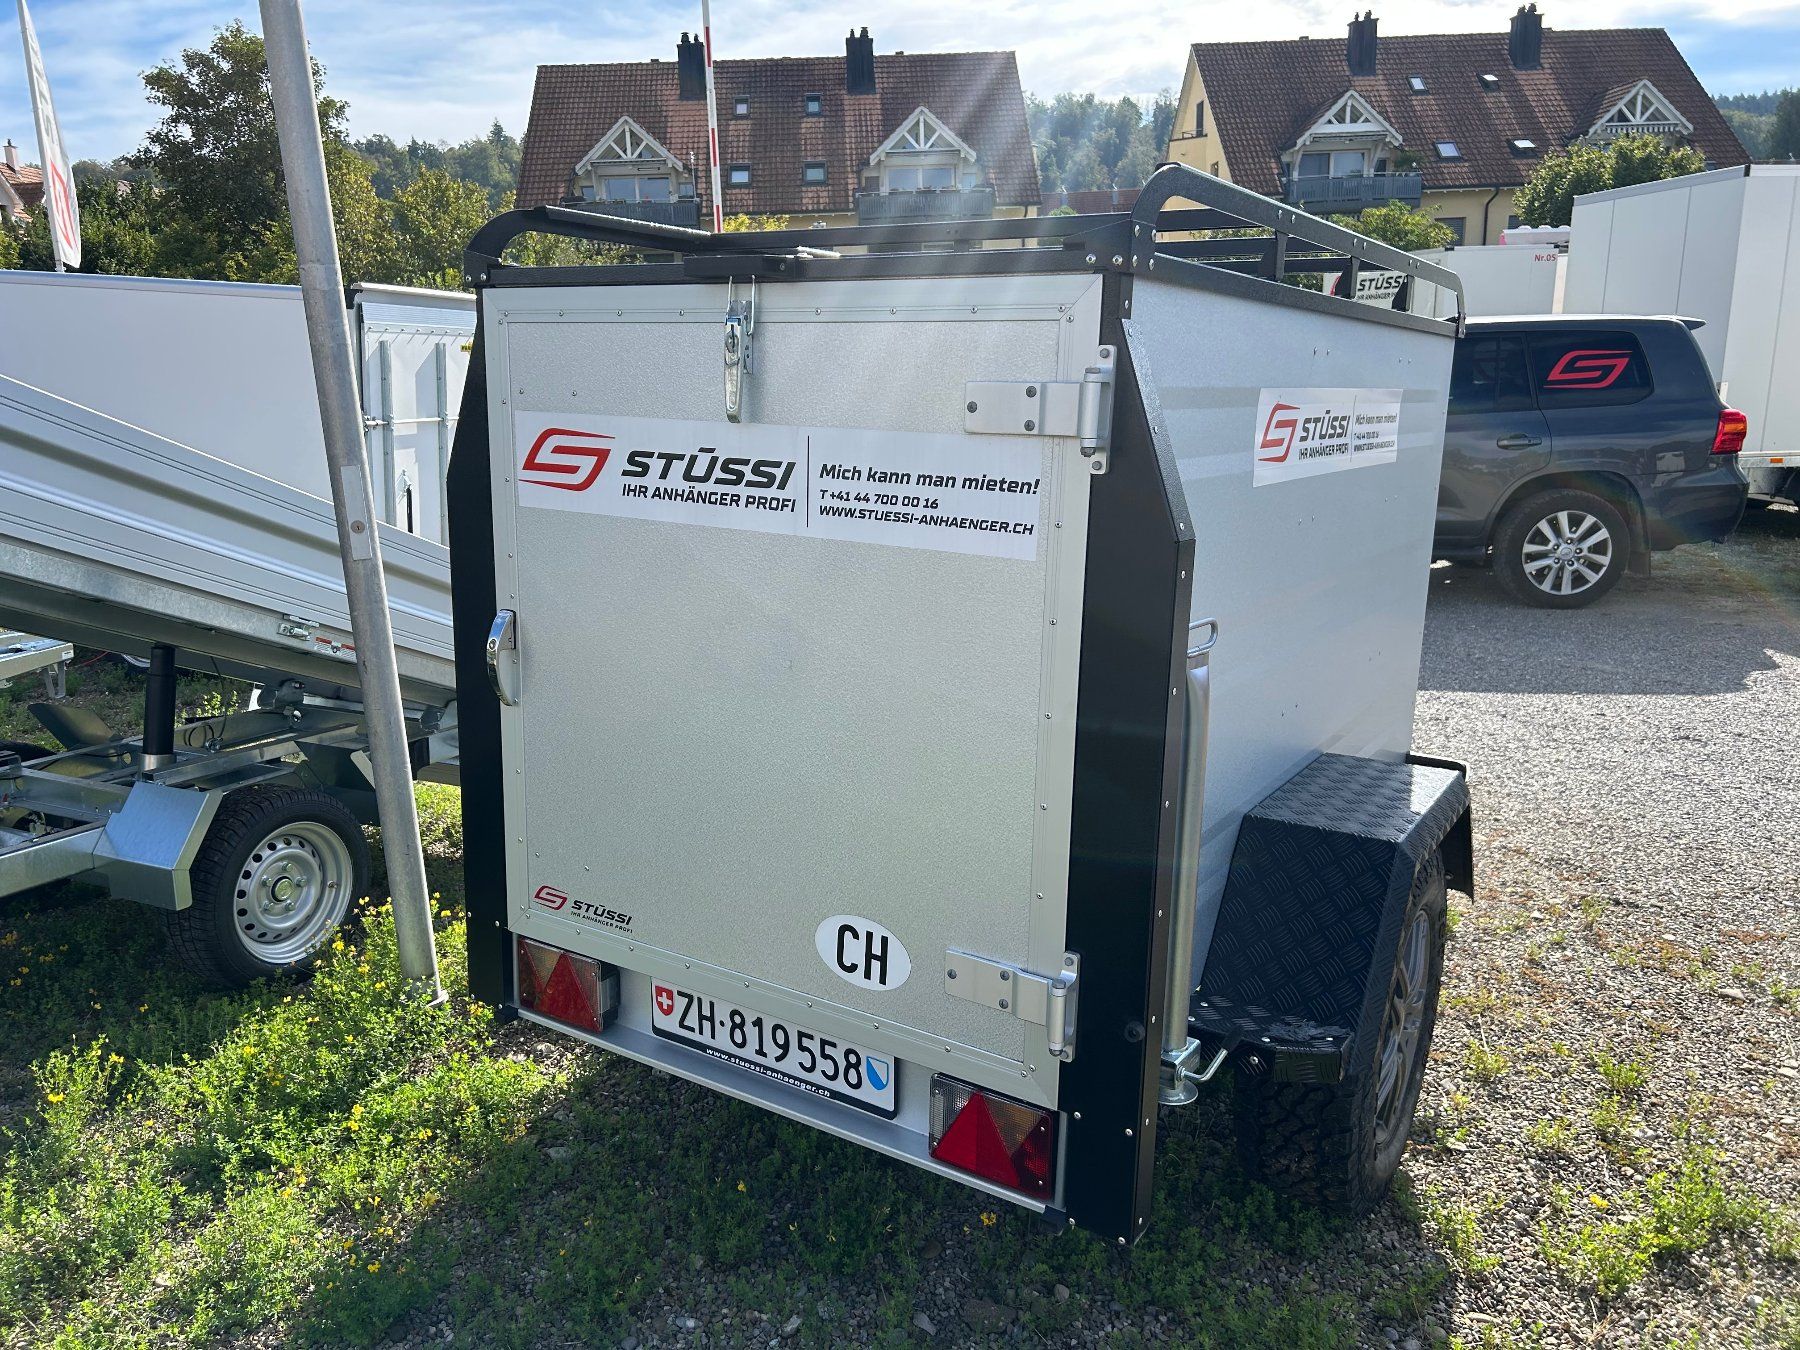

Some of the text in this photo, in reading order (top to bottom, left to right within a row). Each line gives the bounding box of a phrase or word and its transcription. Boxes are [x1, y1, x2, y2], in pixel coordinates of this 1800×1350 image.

[819, 463, 1041, 495] Mich kann man mieten!
[622, 483, 797, 513] IHR ANHÄNGER PROFI
[819, 489, 939, 510] T +41 44 700 00 16
[819, 505, 1035, 536] WWW.STUESSI-ANHAENGER.CH
[836, 923, 889, 986] CH
[706, 1048, 831, 1098] www.stuessi-anhaenger.ch
